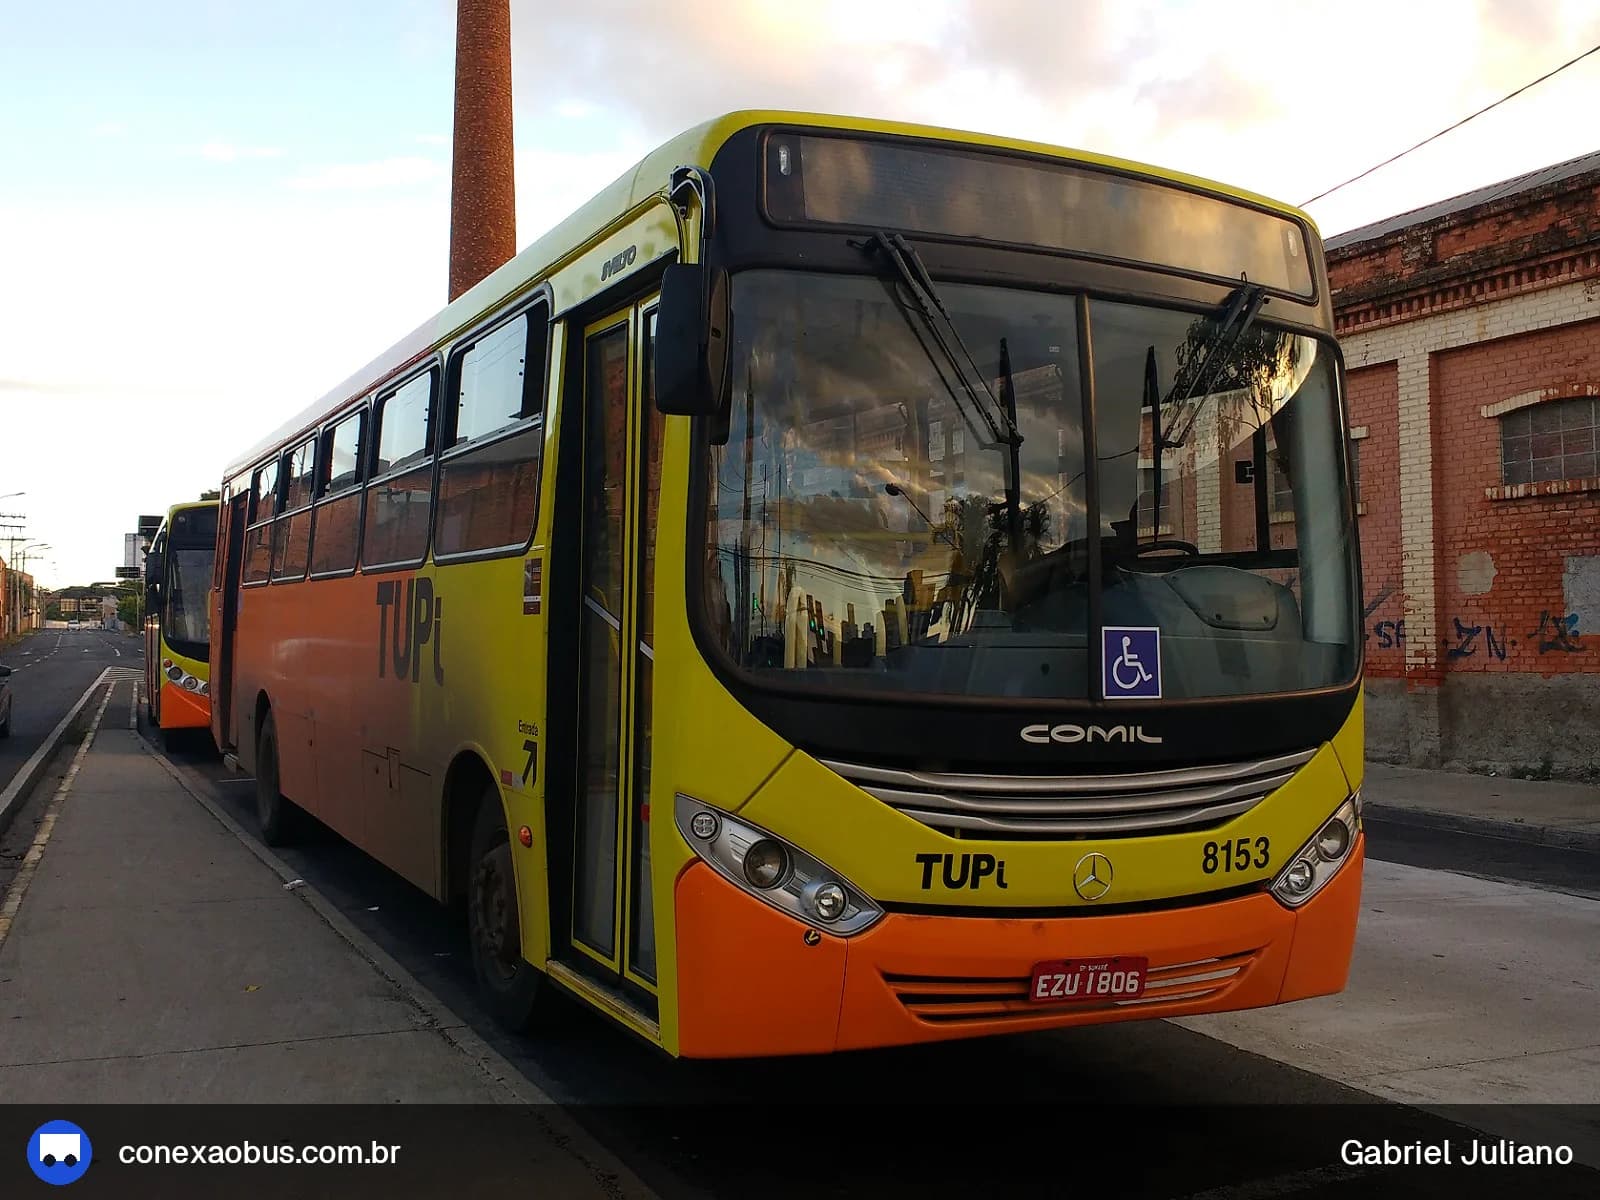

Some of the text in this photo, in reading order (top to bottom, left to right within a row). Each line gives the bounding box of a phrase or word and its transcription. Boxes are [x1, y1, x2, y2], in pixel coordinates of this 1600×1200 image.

[1020, 724, 1163, 744] COMIL
[1202, 836, 1270, 874] 8153
[1036, 971, 1140, 998] EZU 1806
